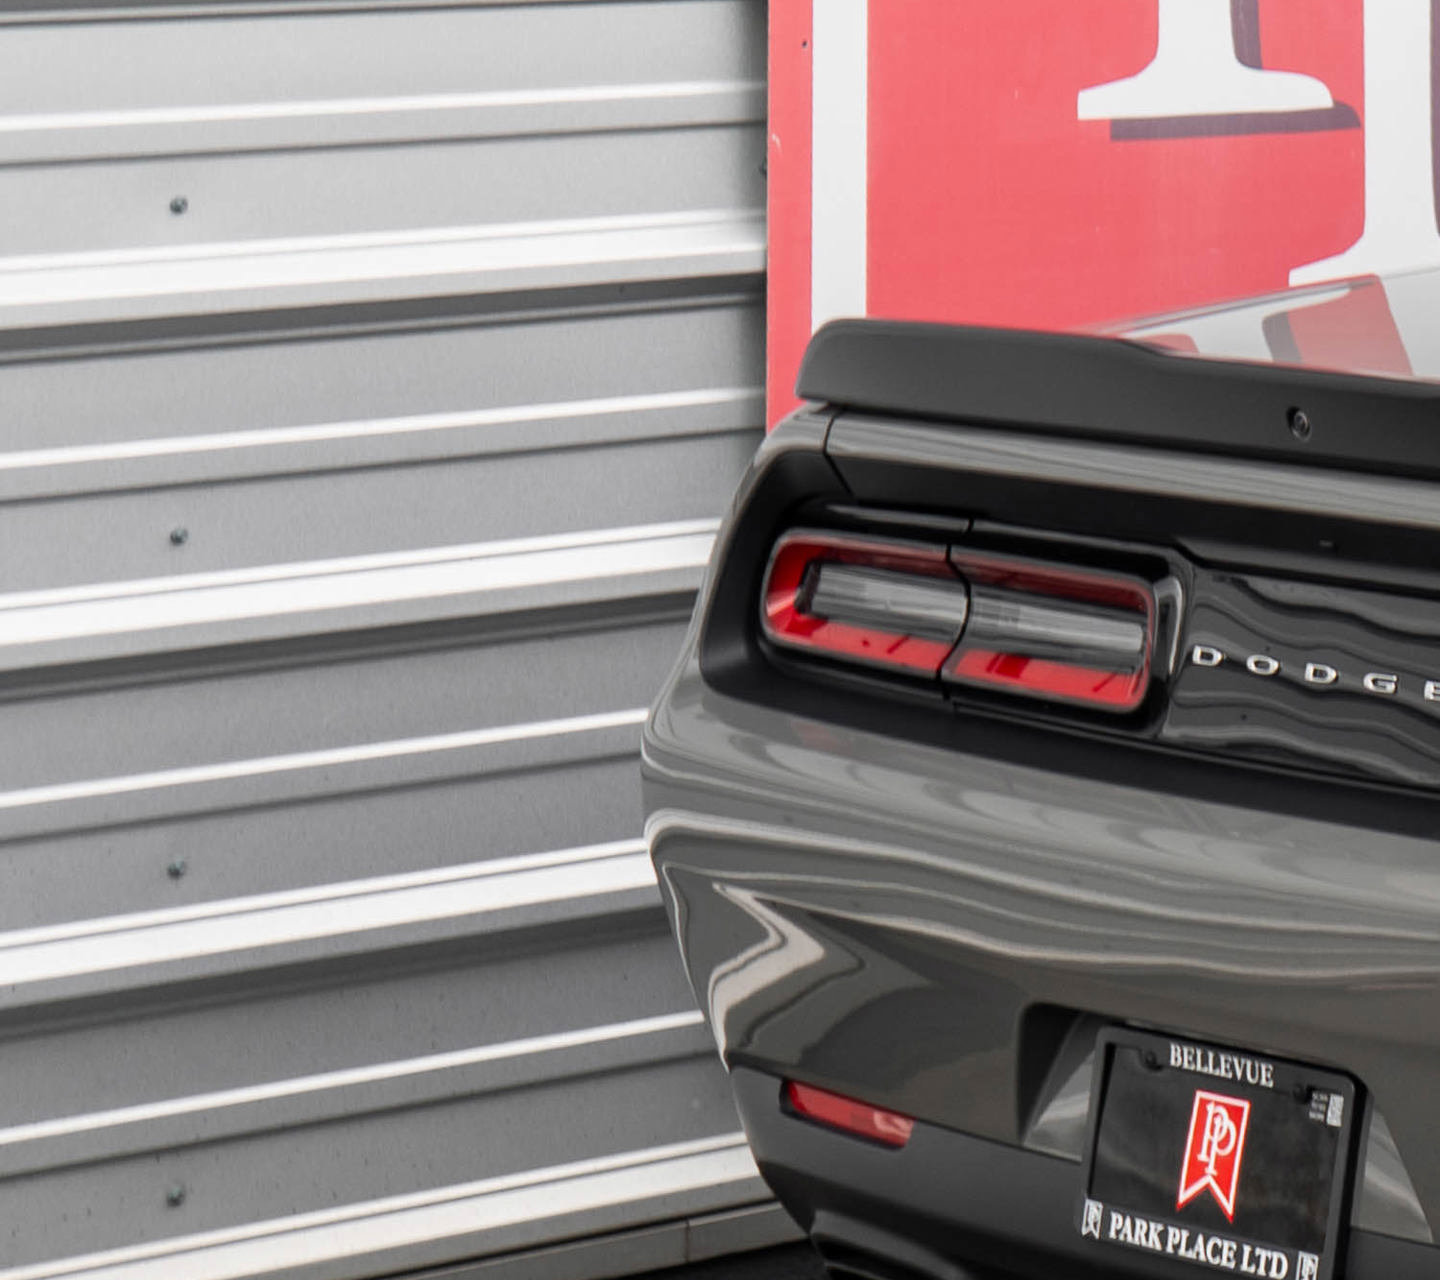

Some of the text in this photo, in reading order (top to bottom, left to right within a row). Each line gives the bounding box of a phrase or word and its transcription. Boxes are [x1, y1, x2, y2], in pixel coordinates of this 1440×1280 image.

[1169, 1042, 1274, 1088] BELLEVUE
[1108, 1211, 1164, 1251] PARK
[1165, 1225, 1237, 1270] PLACE
[1240, 1243, 1289, 1280] LTD
